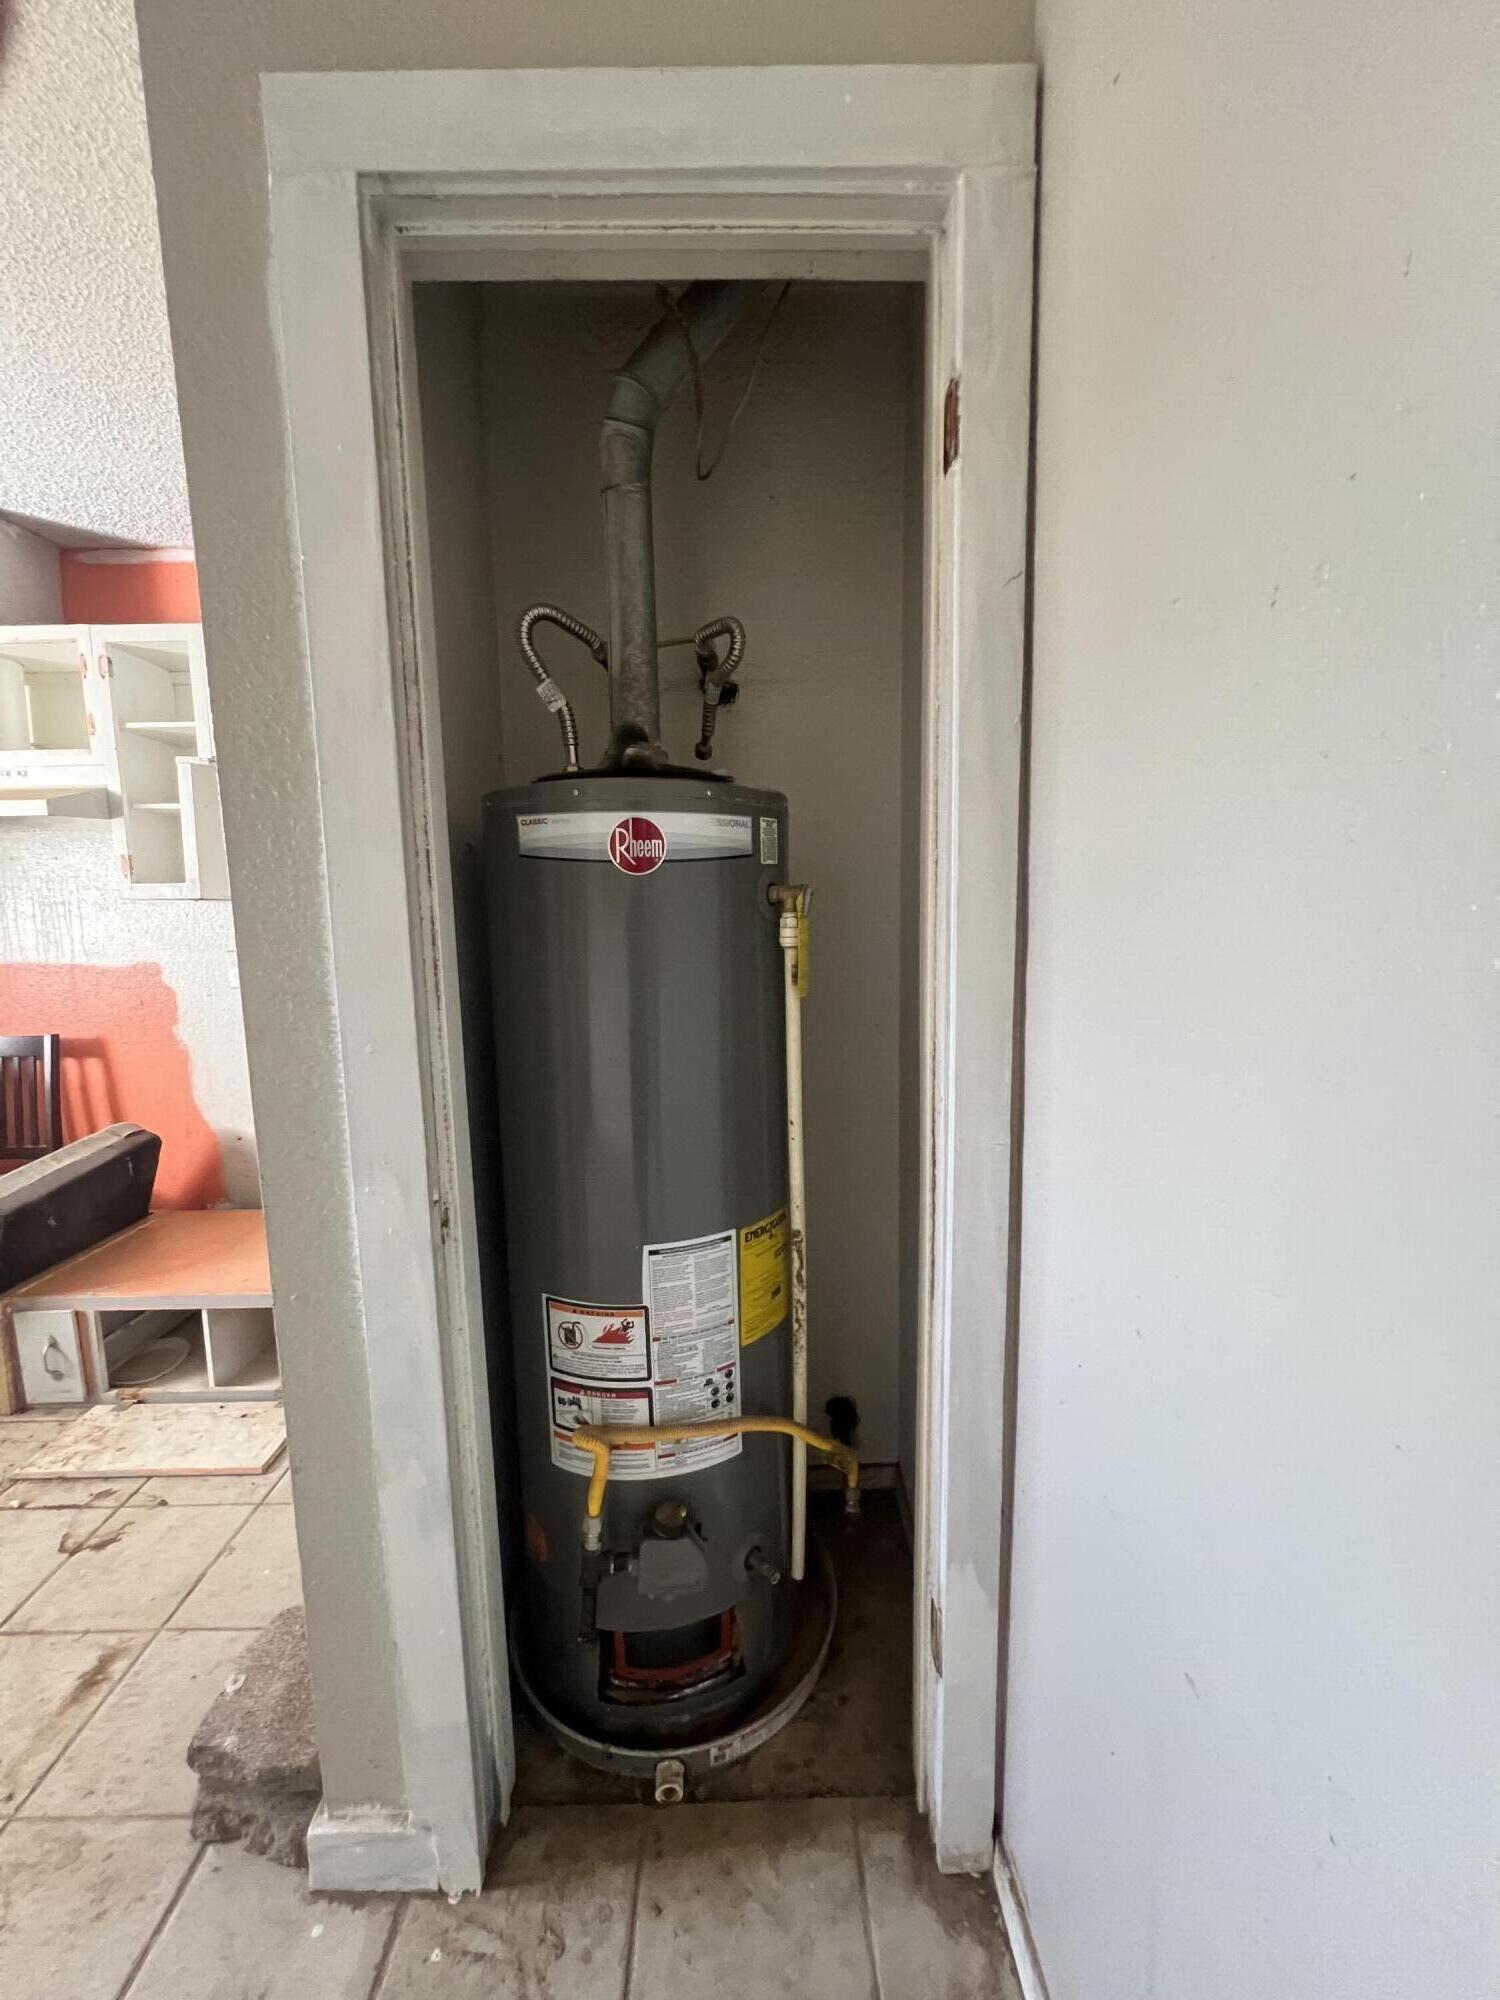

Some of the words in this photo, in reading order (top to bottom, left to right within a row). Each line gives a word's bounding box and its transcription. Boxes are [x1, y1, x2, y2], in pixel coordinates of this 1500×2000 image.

[520, 818, 548, 826] CLASSIC
[615, 817, 663, 865] Rheem
[586, 1390, 617, 1398] DANGER
